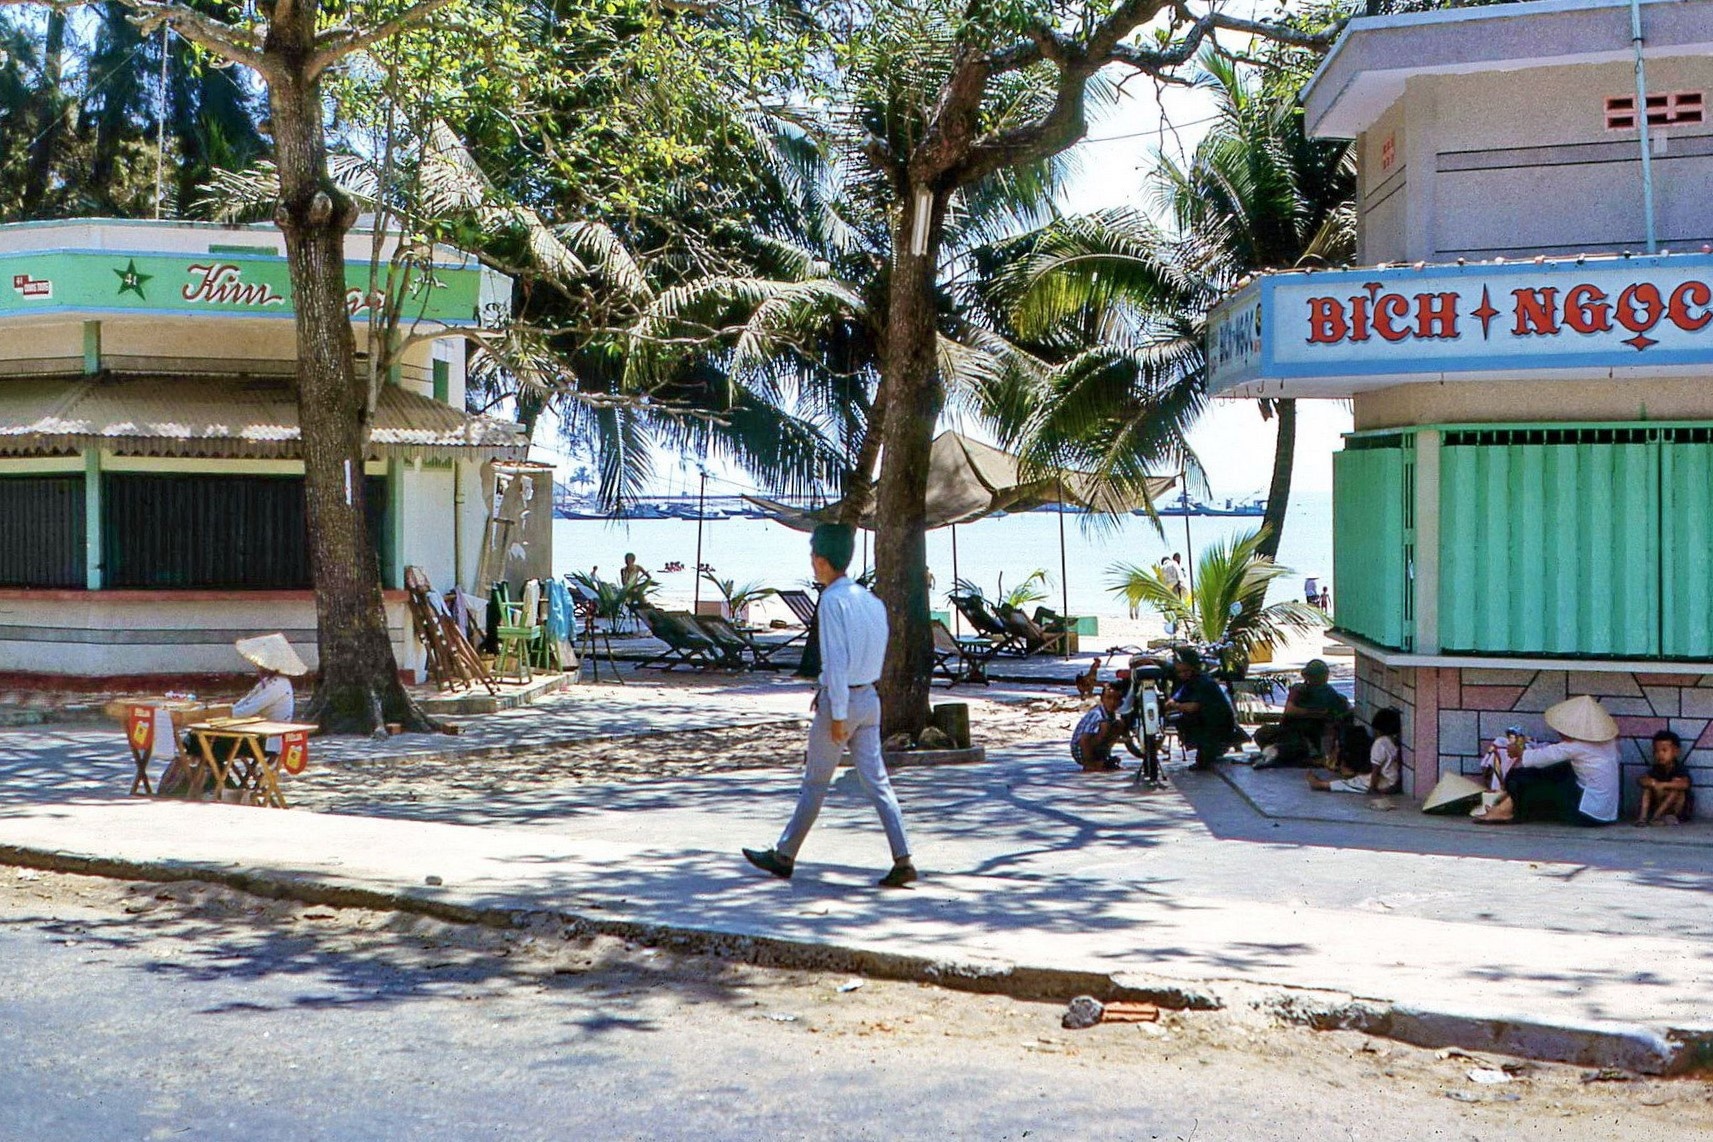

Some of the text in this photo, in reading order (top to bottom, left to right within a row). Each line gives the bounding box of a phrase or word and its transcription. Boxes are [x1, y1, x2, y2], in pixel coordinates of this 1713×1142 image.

[124, 273, 138, 286] 41
[182, 263, 285, 306] Kim
[1305, 282, 1462, 345] BÍCH
[1510, 280, 1713, 352] NGỌC
